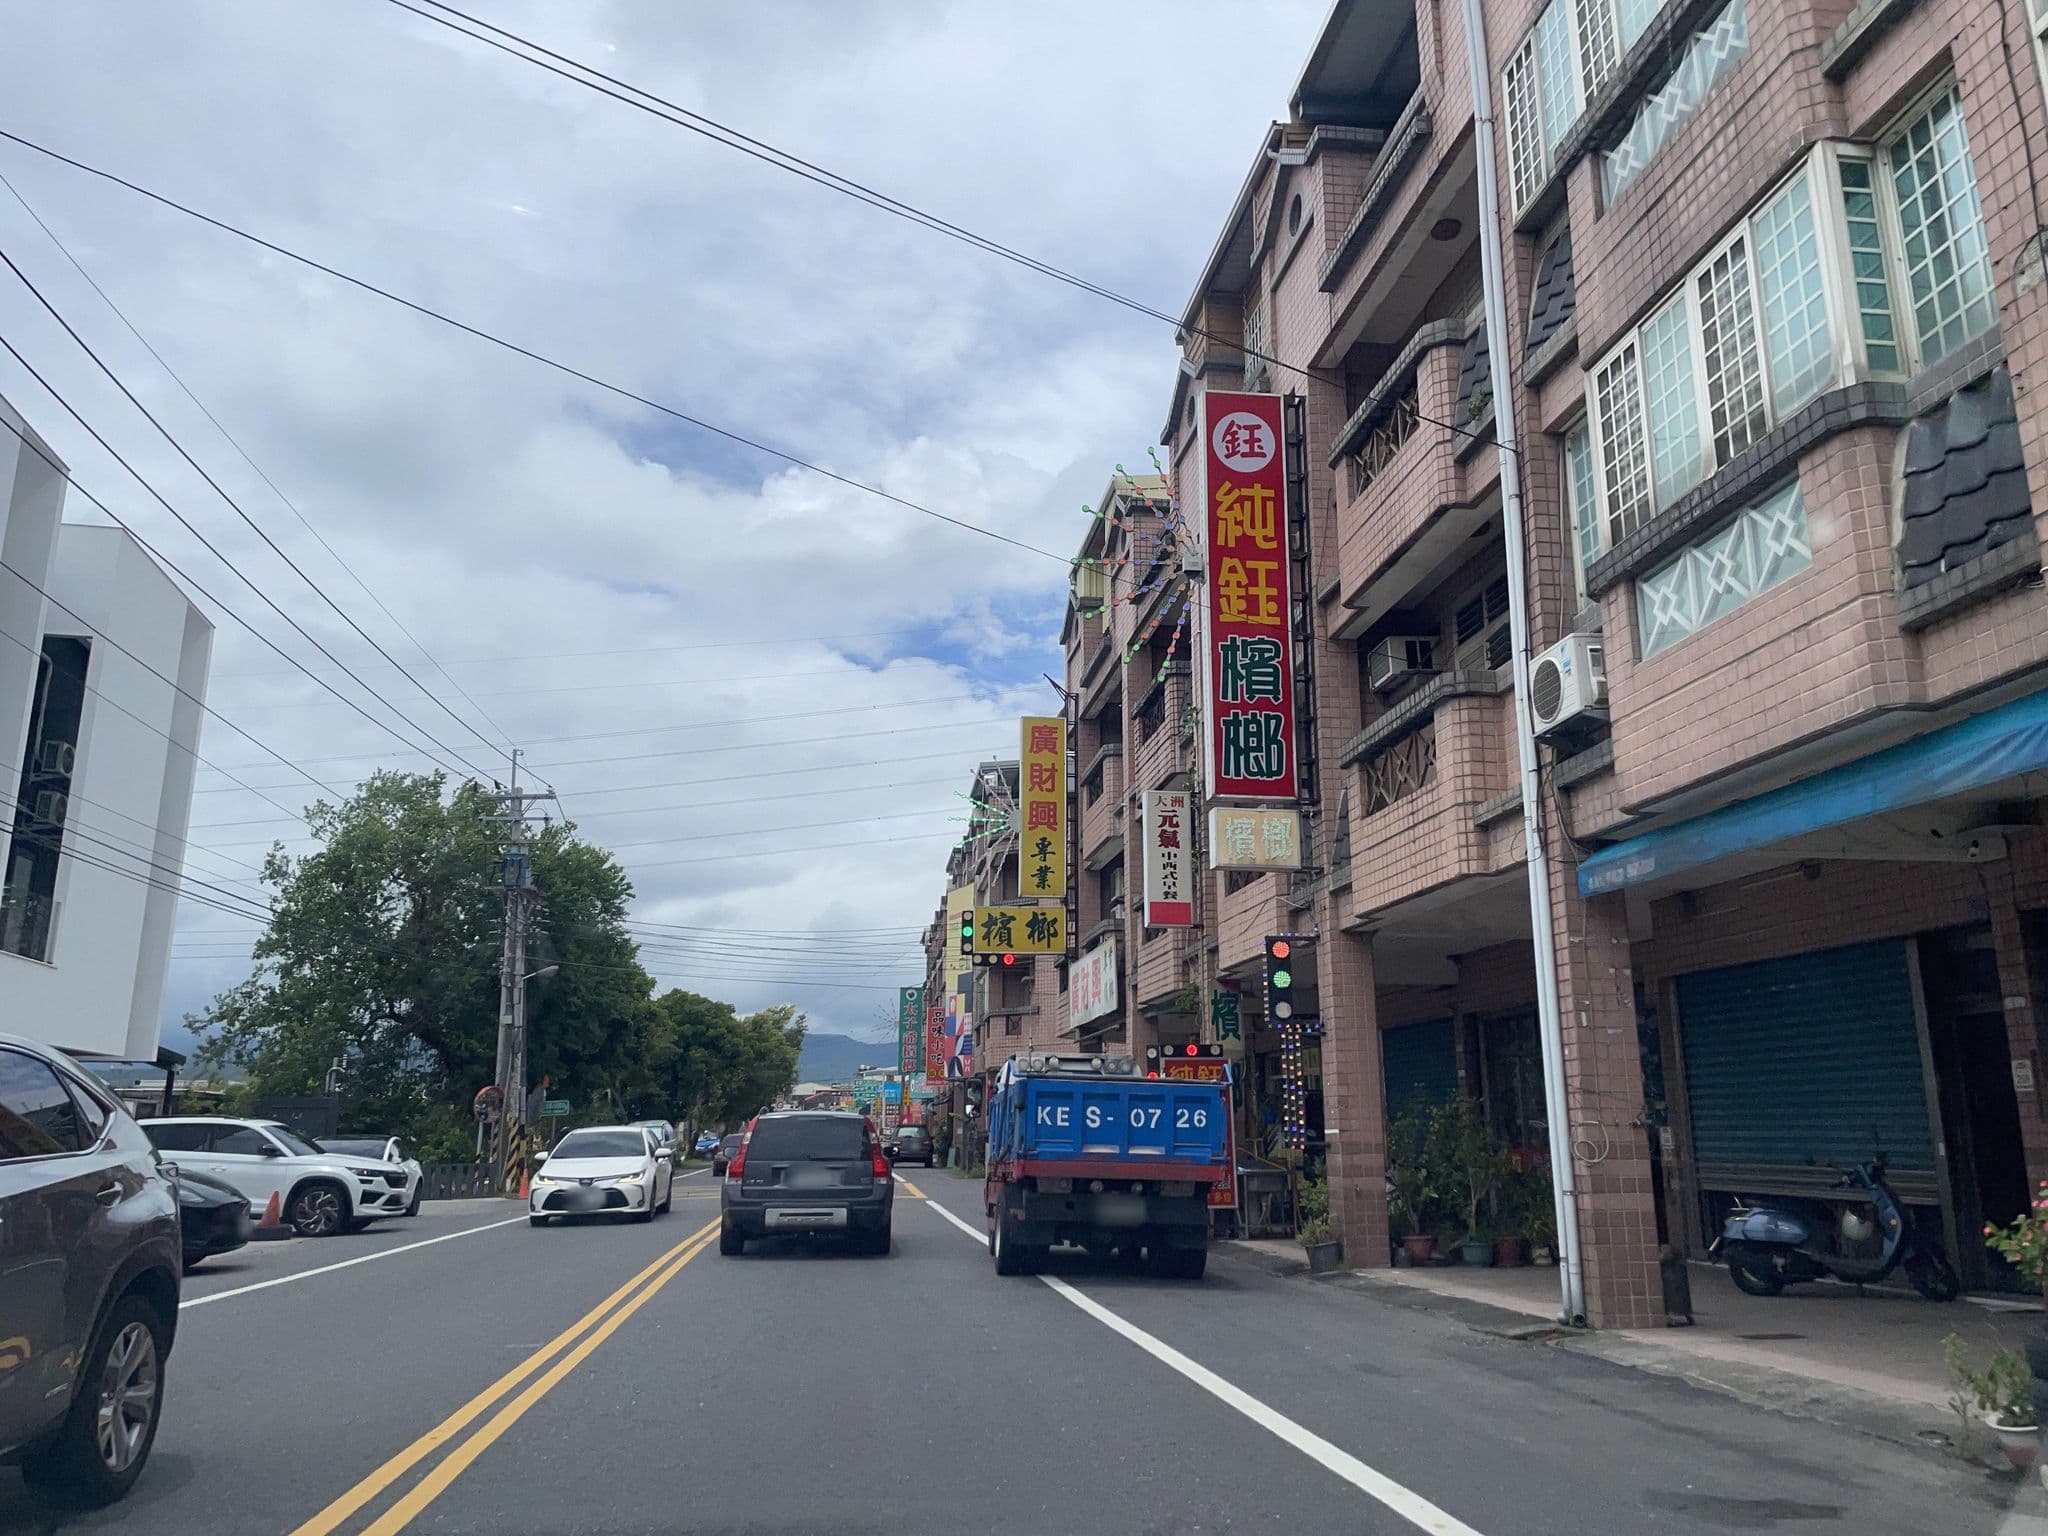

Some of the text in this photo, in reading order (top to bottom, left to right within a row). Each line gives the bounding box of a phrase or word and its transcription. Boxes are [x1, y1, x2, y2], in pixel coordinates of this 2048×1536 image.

[1222, 420, 1267, 459] 鈺
[980, 911, 1059, 949] 檳榔
[931, 1011, 944, 1065] 品味小吃
